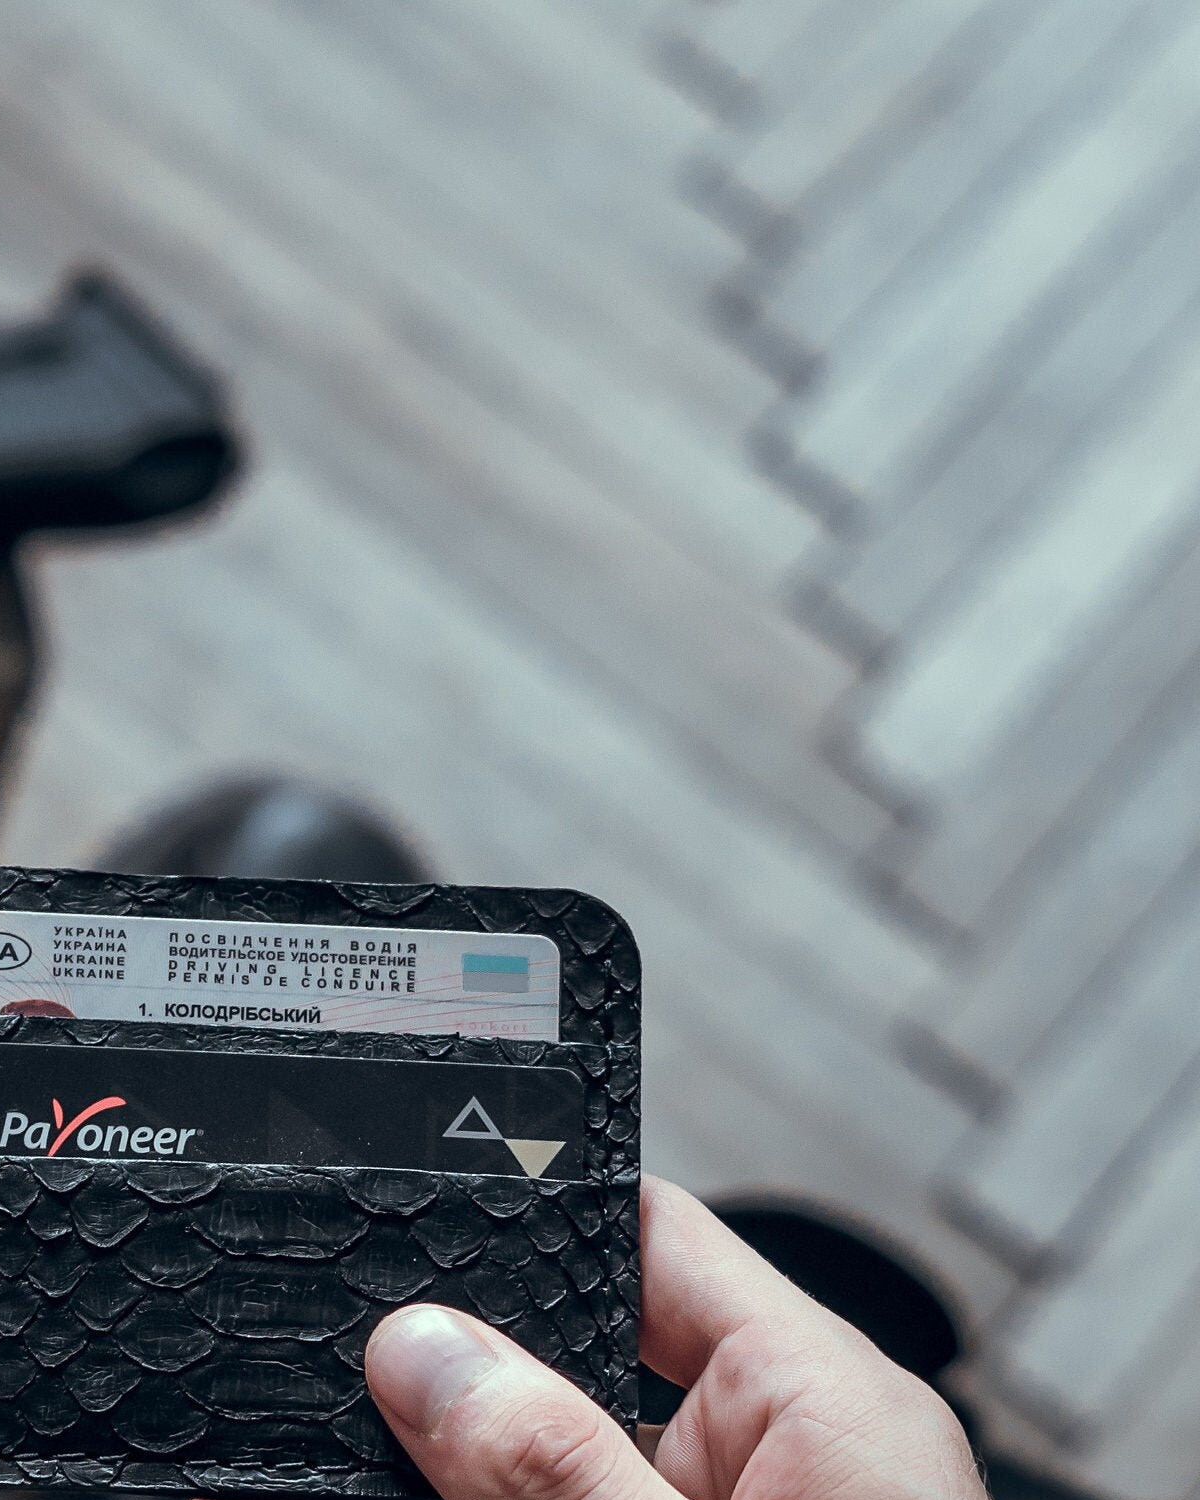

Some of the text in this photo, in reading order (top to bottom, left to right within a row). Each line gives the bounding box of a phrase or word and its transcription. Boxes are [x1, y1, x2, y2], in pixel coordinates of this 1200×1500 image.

[53, 926, 128, 939] УКРАЇНА
[169, 932, 418, 954] ПОСВІДЧЕННЯ ВОДІЯ
[53, 940, 127, 953] УКРАИНА
[169, 946, 417, 967] ВОДИТЕЛЬСКОЕ УДОСТОВЕРЕНИЕ
[53, 953, 126, 967] UKRAINE
[169, 960, 417, 981] DRIVING LICENCE
[52, 967, 125, 980] UKRAINE
[168, 972, 417, 993] PERMIS DE CONDUIRE
[138, 1003, 322, 1025] 1. КОЛОДРІБСЬКИЙ
